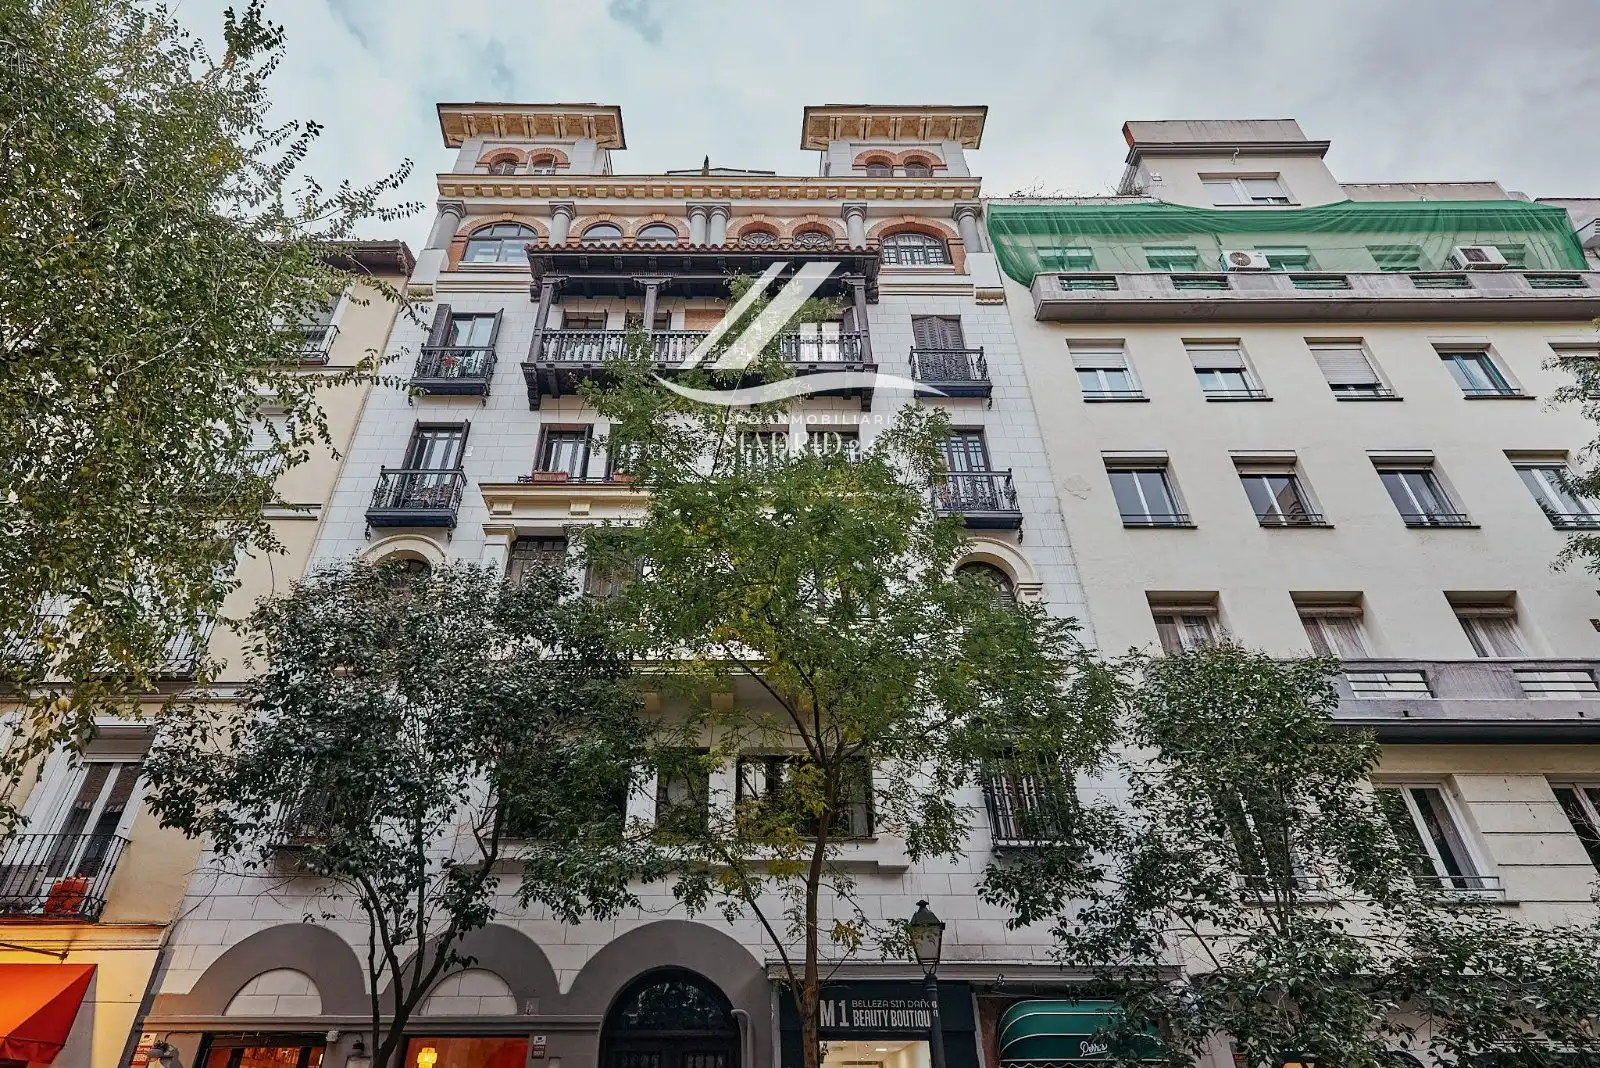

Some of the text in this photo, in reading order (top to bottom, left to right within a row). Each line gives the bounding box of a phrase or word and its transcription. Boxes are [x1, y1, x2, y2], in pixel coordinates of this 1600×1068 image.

[819, 999, 849, 1027] M1
[851, 999, 889, 1008] BELLEZA
[890, 999, 906, 1008] SIN
[852, 1009, 931, 1028] BEAUTY BOUTIQU
